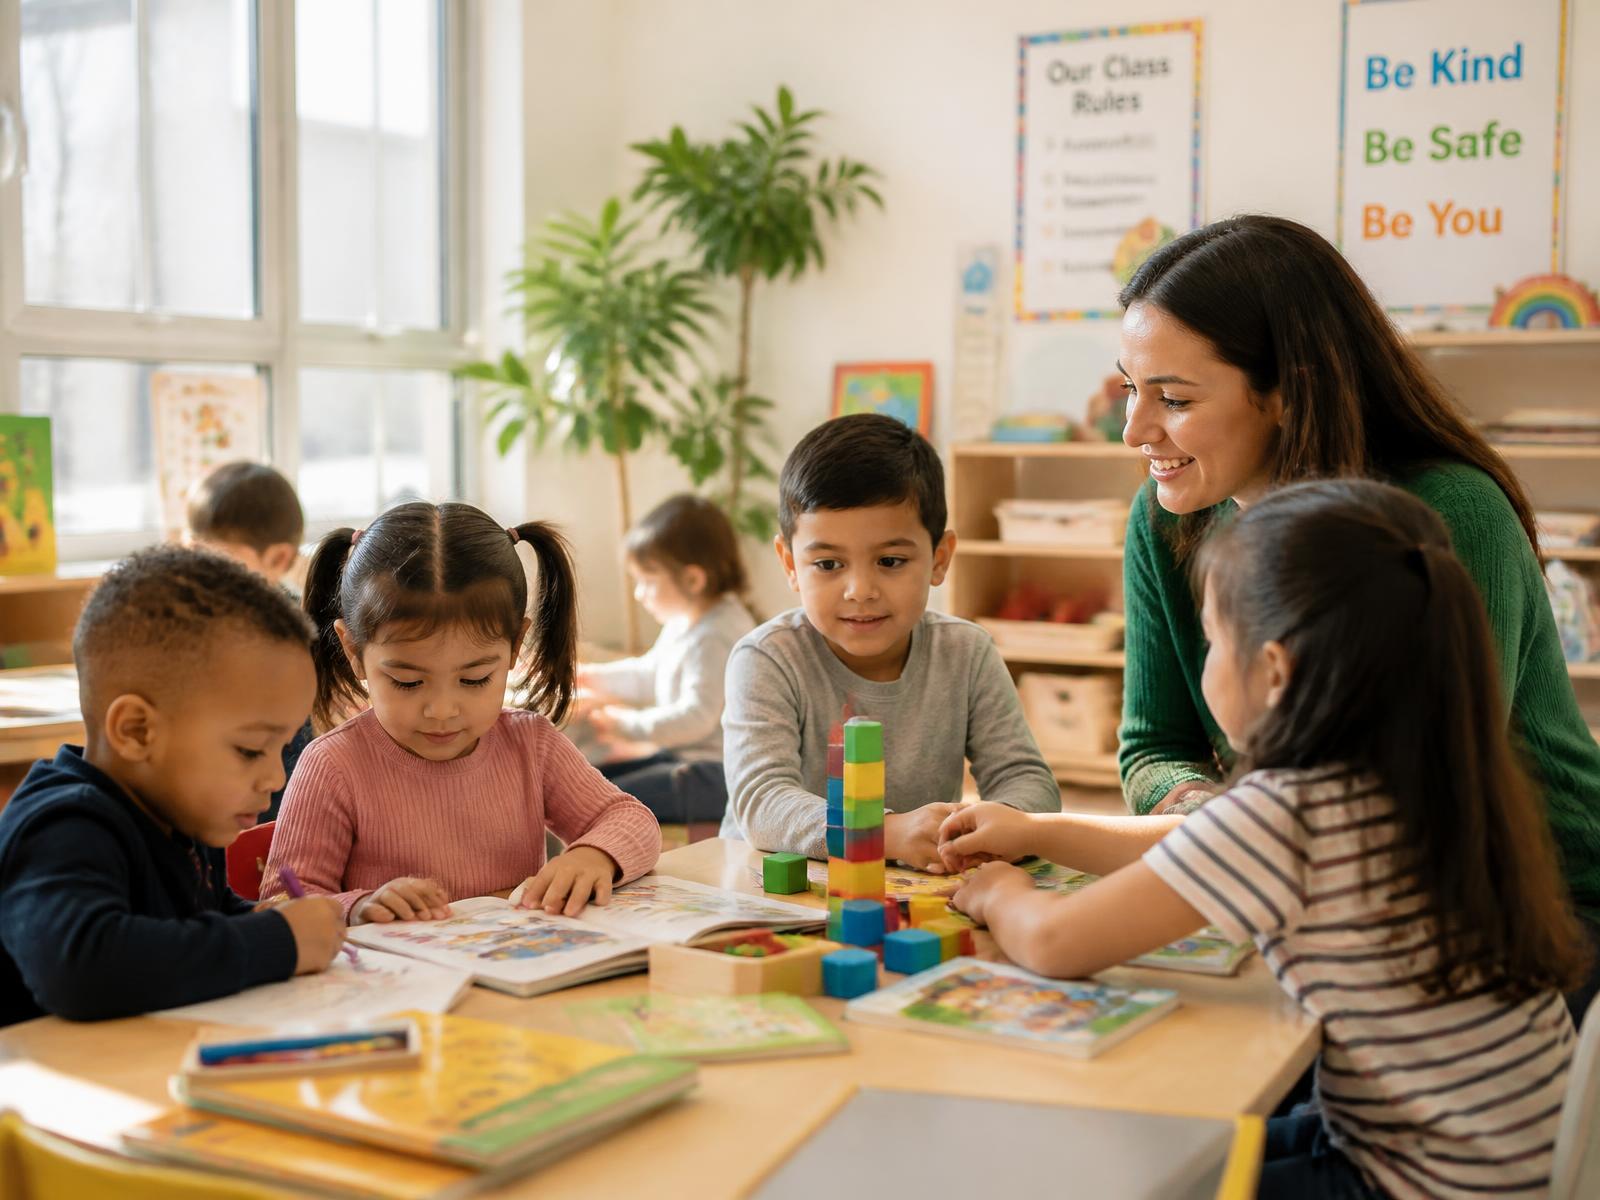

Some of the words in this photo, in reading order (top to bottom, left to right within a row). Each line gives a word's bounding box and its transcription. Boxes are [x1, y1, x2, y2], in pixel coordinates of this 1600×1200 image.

[1046, 60, 1093, 86] Our
[1103, 53, 1171, 82] Class
[1365, 55, 1415, 91] Be
[1431, 43, 1523, 86] Kind
[1071, 89, 1141, 116] Rules
[1364, 130, 1415, 166] Be
[1430, 120, 1523, 162] Safe
[1362, 204, 1413, 241] Be
[1427, 201, 1503, 237] You
